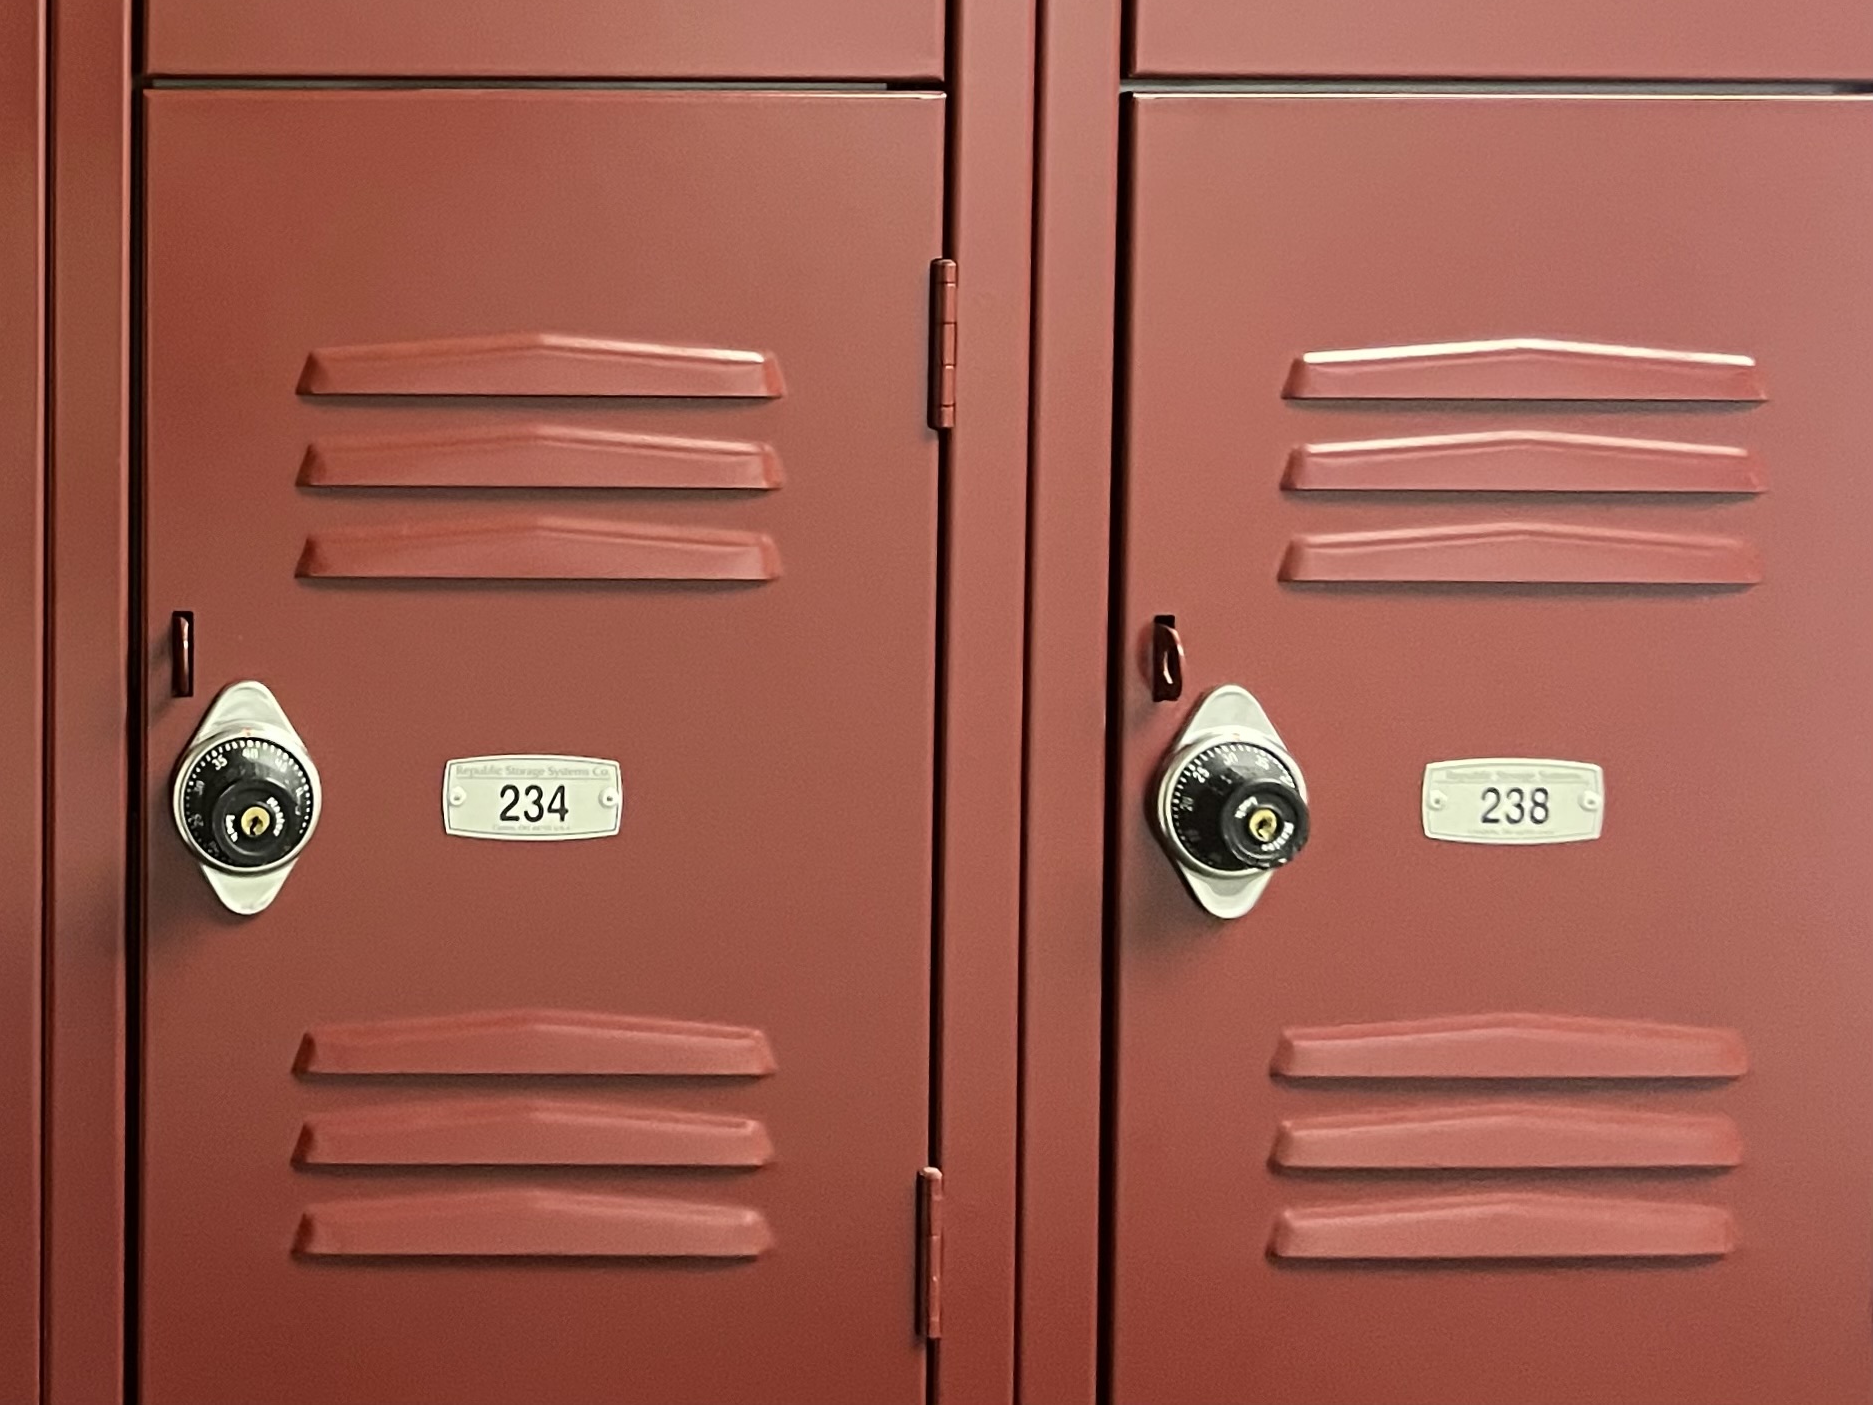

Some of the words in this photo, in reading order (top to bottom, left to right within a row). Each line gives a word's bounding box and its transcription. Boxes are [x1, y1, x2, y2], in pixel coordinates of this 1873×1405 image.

[211, 754, 228, 771] 35
[456, 766, 503, 778] Republic
[505, 766, 545, 778] Storage
[547, 766, 589, 778] Systems
[499, 783, 570, 823] 234
[1480, 786, 1551, 825] 238
